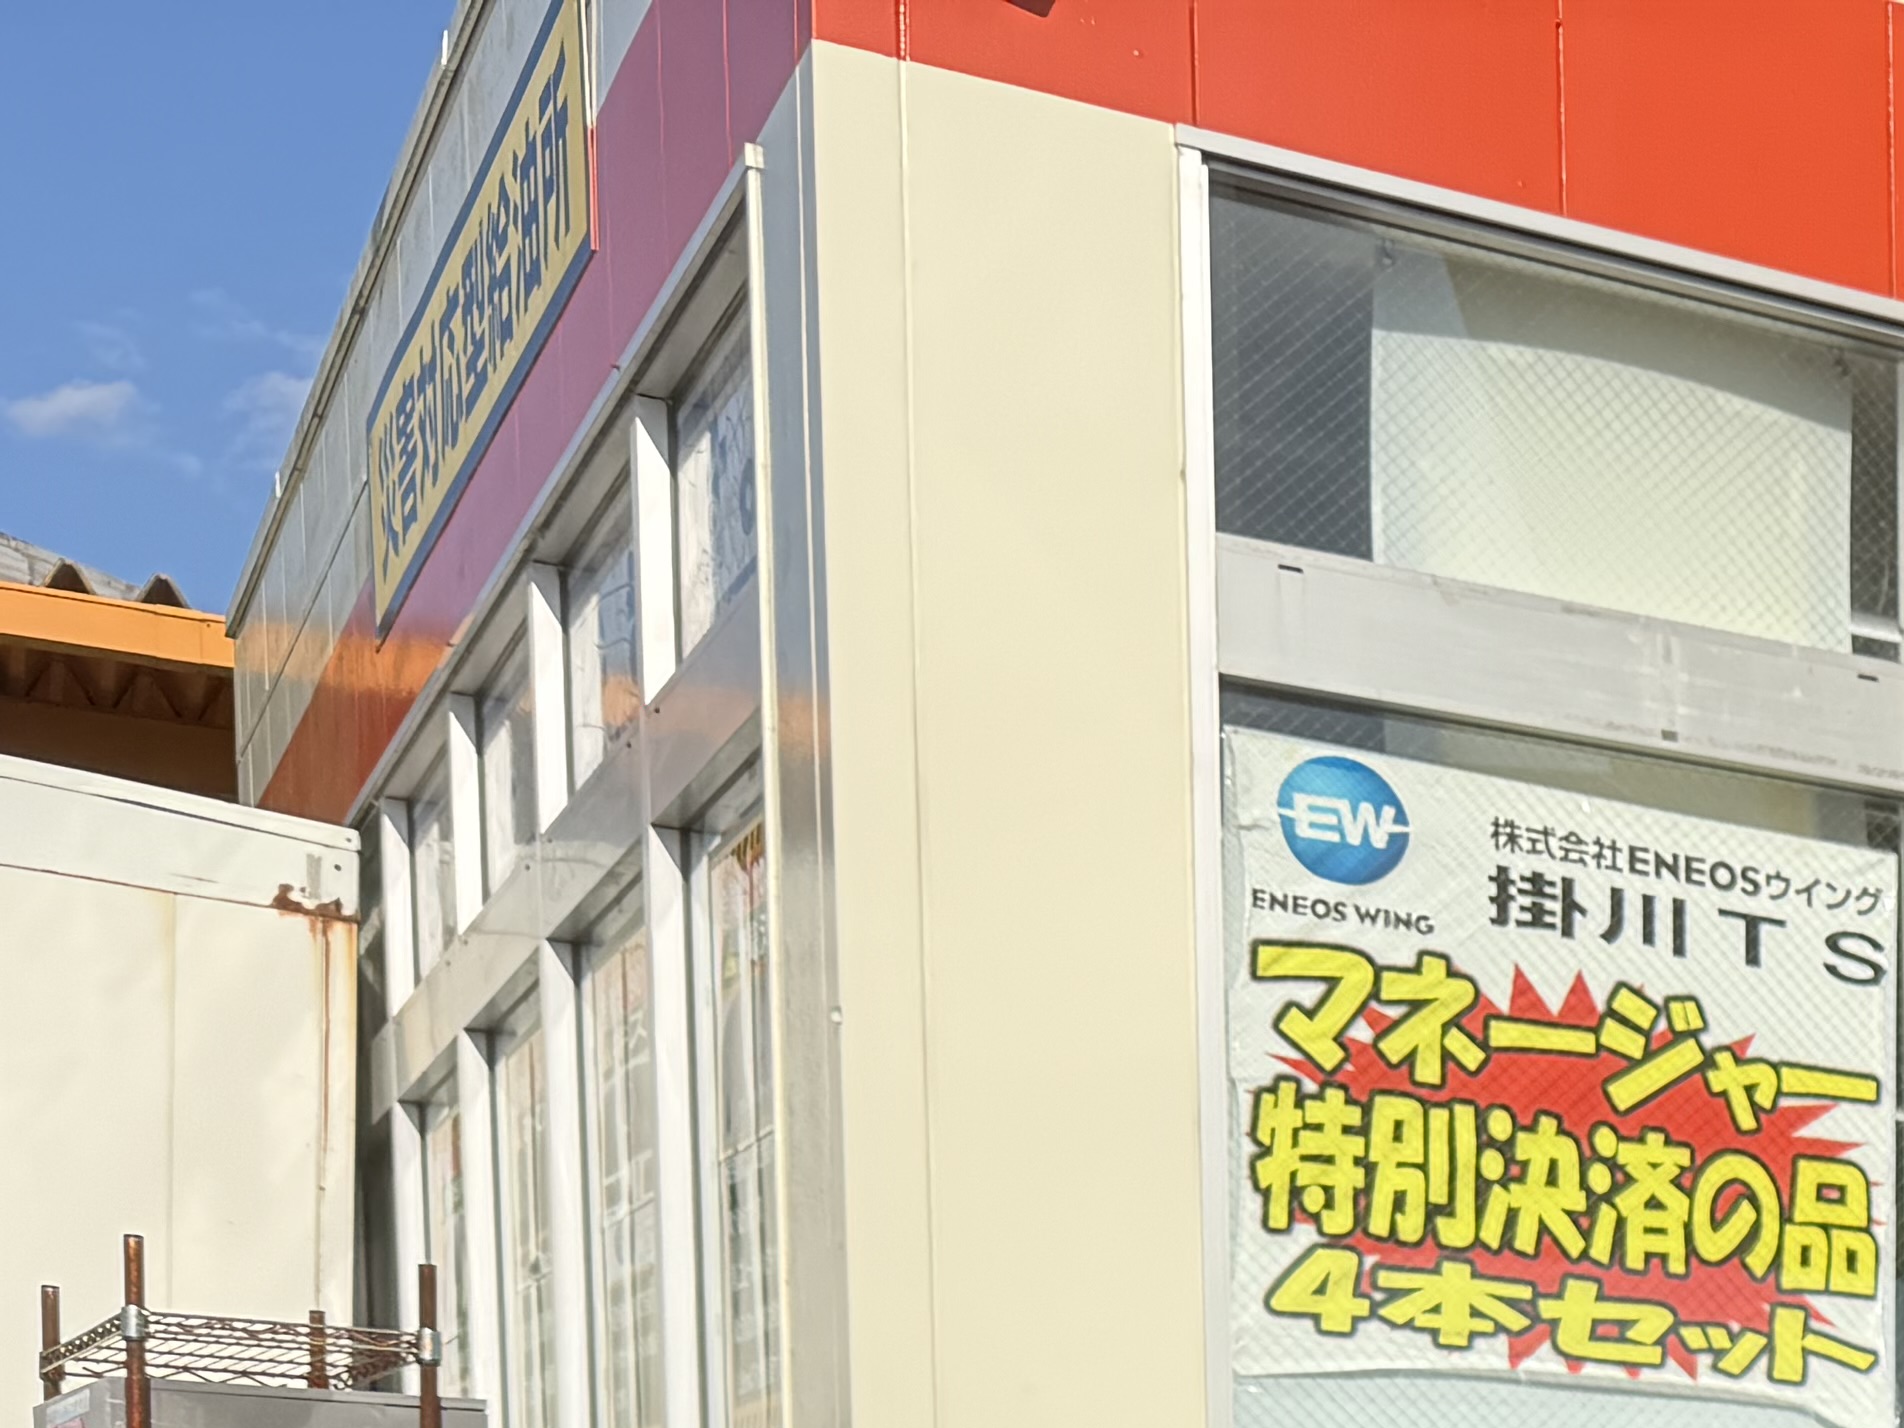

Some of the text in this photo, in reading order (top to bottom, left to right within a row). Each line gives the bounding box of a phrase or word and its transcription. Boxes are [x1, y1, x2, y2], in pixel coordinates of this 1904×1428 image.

[377, 39, 574, 569] 災害対応型給油所
[1251, 887, 1435, 936] ENEOS WING
[1489, 815, 1884, 917] 株式会社ENEOSウイング
[1250, 937, 1883, 1134] マネージャー
[1249, 1074, 1880, 1299] 特別決済の品
[1265, 1242, 1880, 1387] 4本セット
